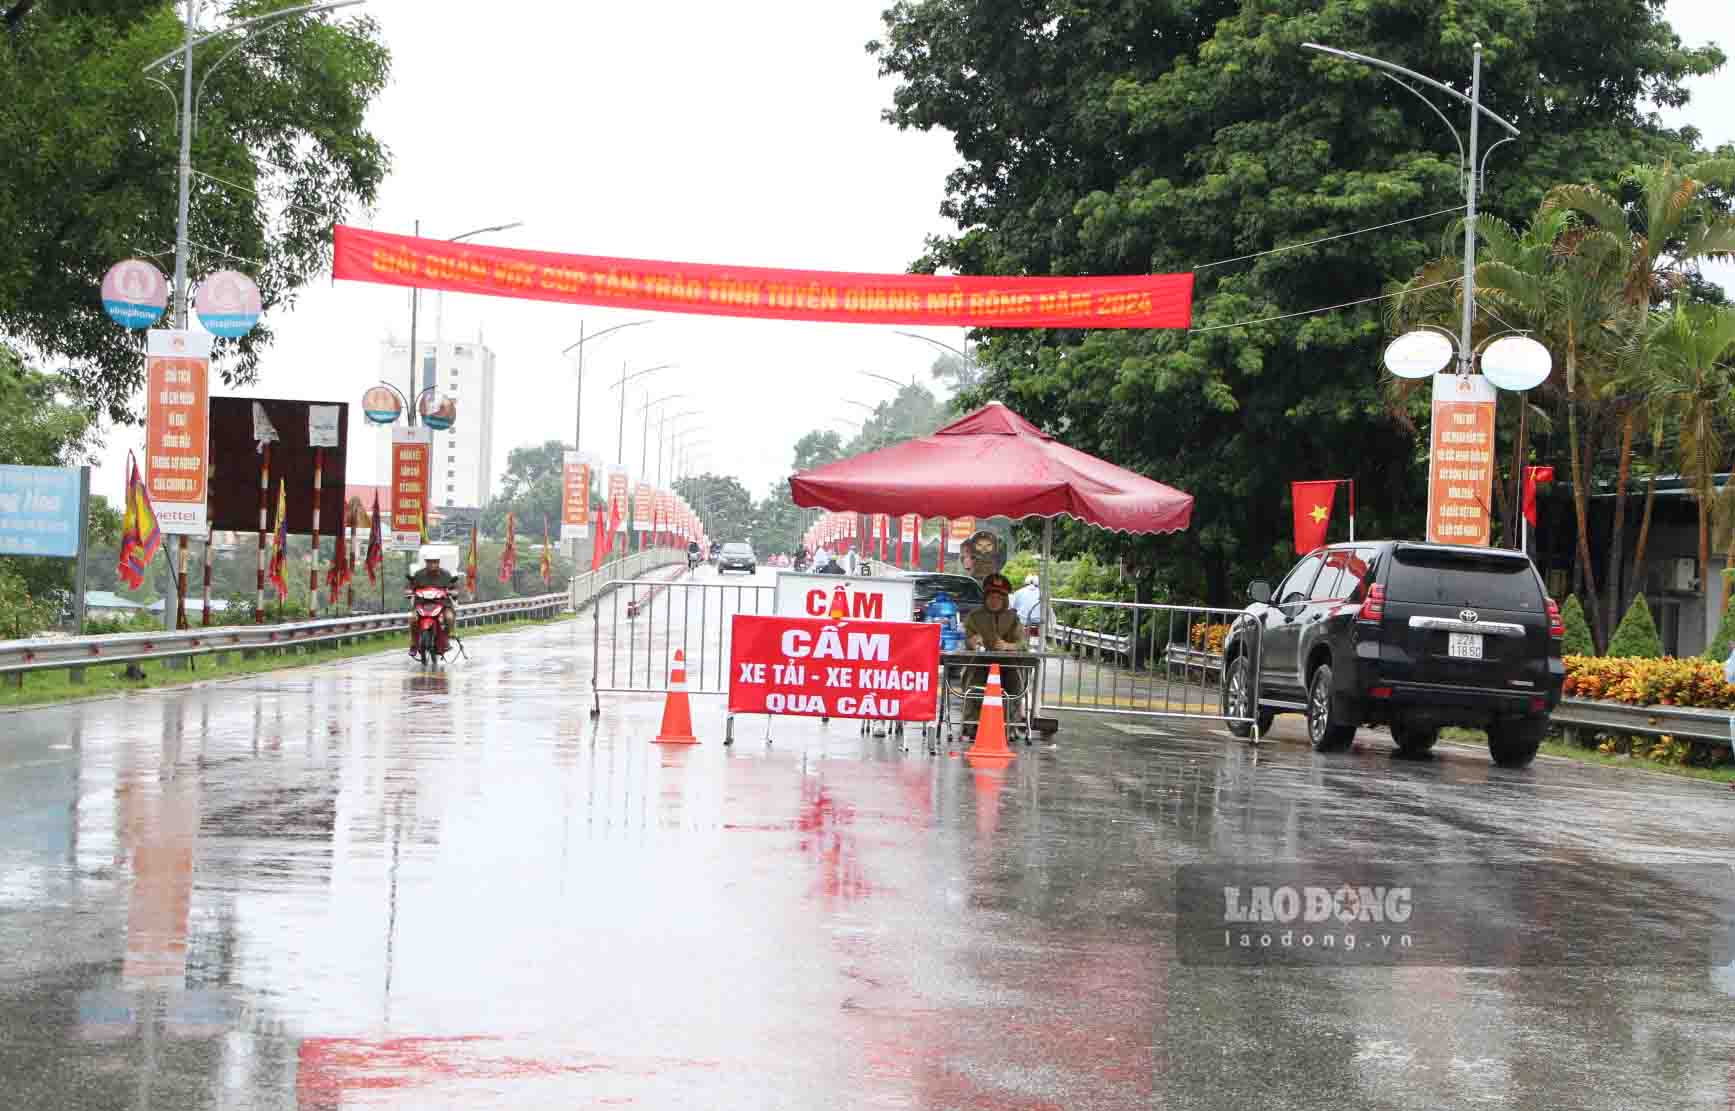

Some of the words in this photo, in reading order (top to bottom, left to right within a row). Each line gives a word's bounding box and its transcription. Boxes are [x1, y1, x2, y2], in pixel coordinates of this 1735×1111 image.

[767, 281, 837, 309] TUYÊN
[1096, 291, 1153, 316] 2024
[780, 621, 891, 662] CẤM
[739, 662, 766, 684] XE
[772, 658, 805, 686] TẢI
[825, 666, 853, 689] XE
[858, 664, 929, 692] KHÁCH
[765, 692, 826, 714] QUA
[836, 691, 901, 717] CẦU
